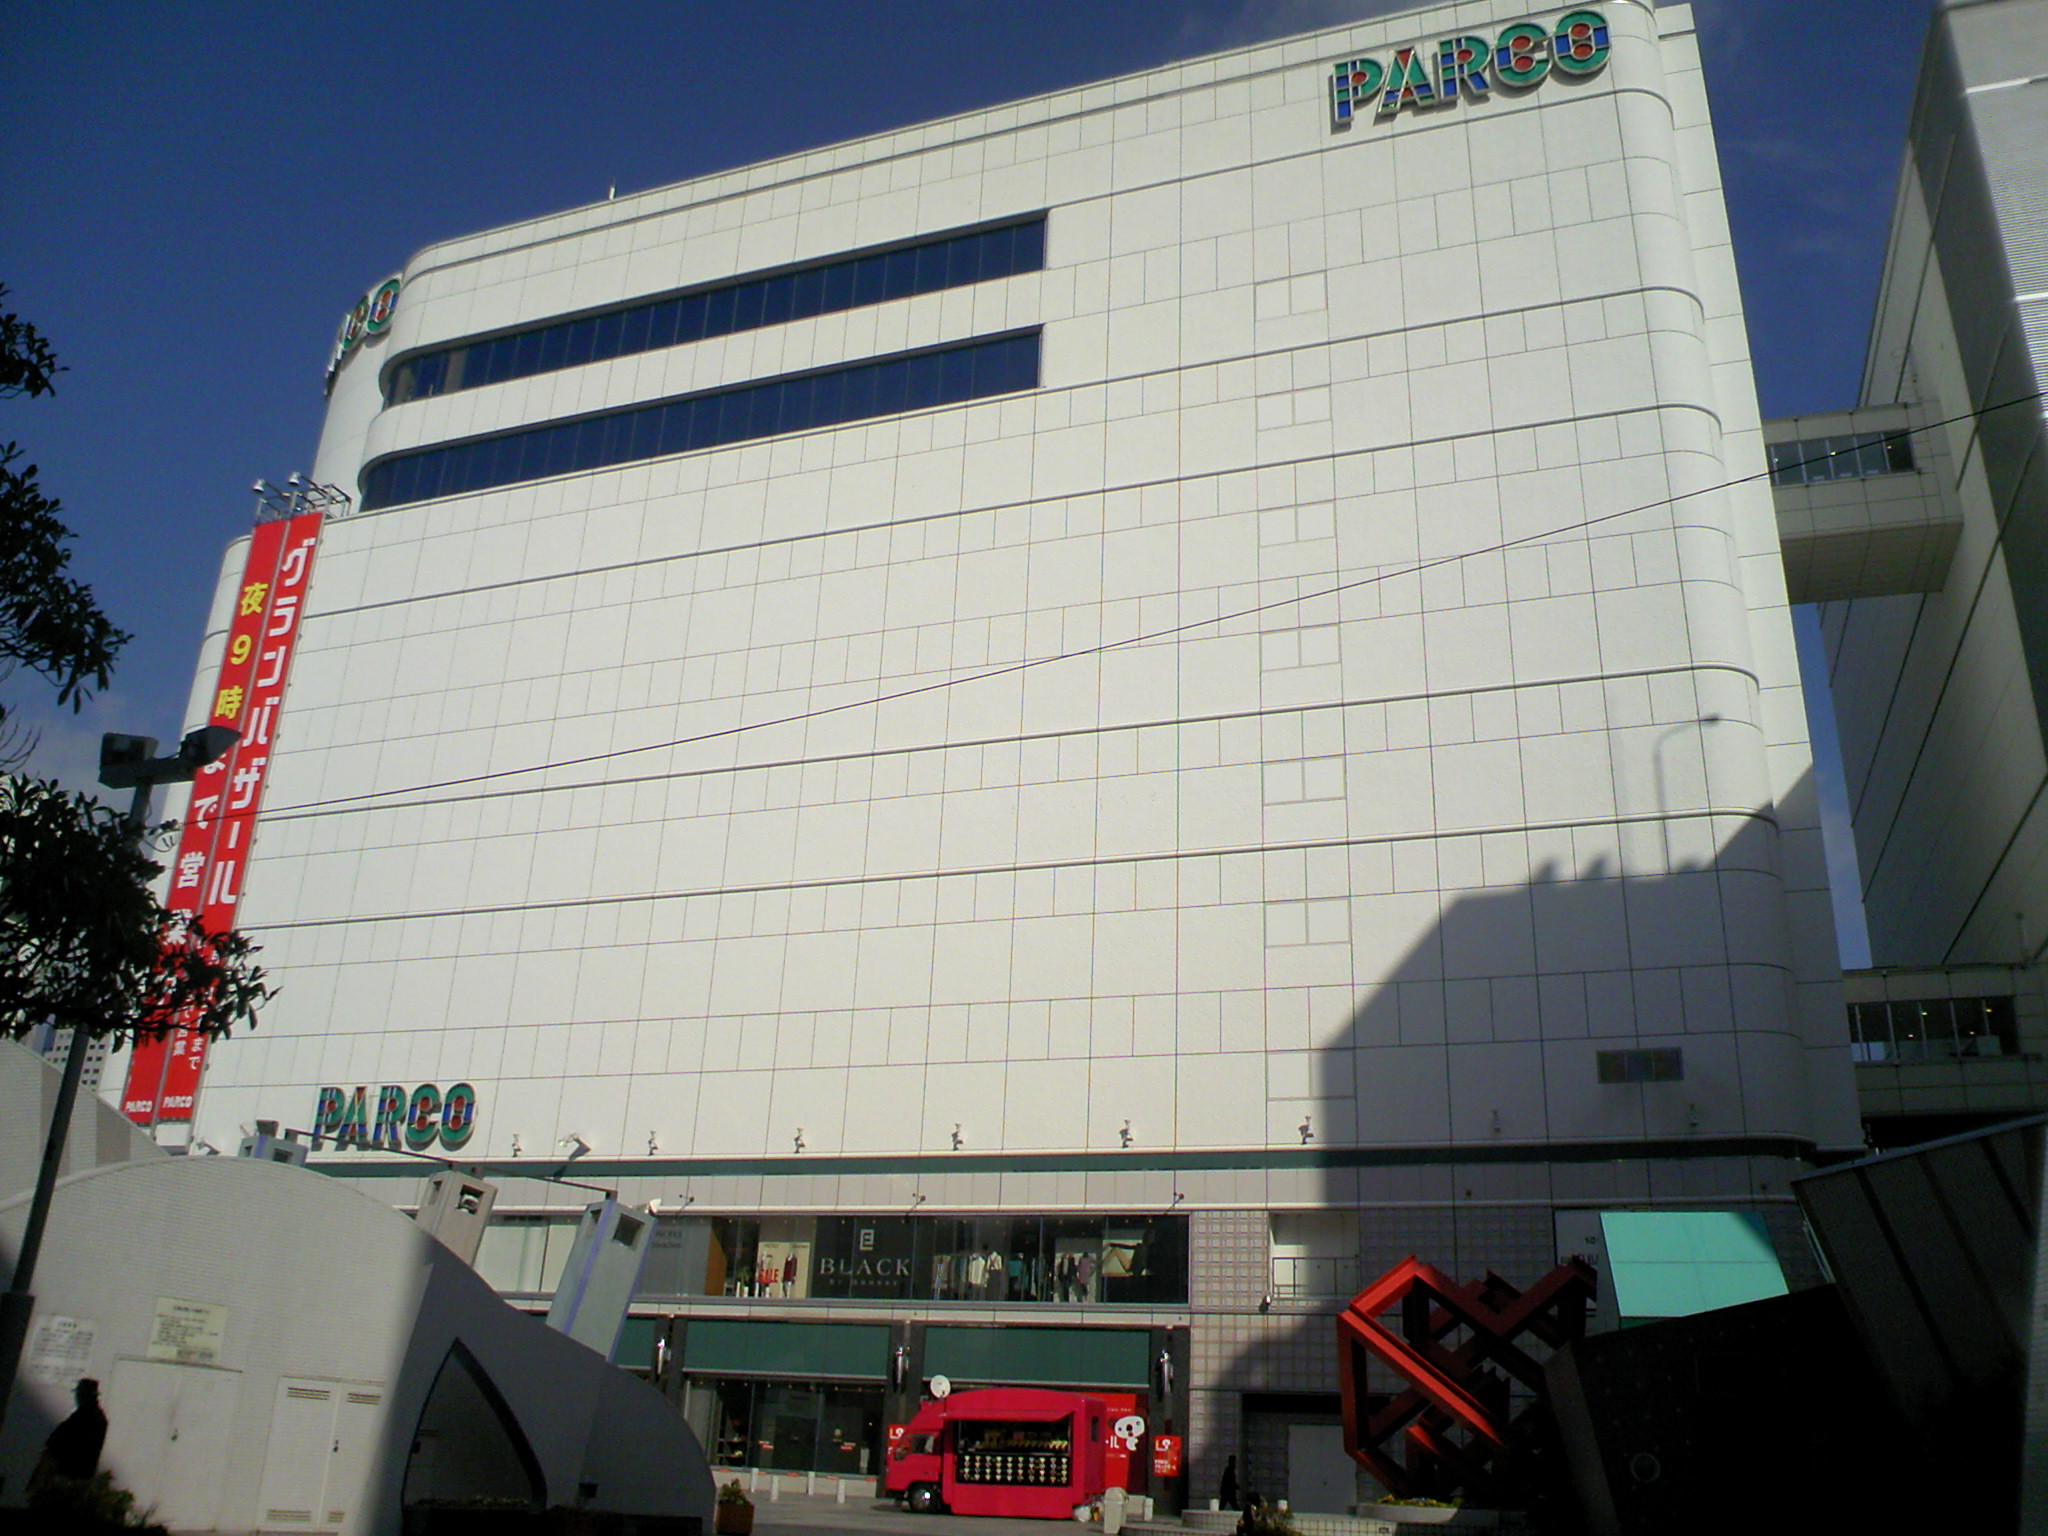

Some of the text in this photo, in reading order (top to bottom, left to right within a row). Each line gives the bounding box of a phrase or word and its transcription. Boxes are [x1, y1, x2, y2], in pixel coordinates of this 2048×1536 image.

[1332, 9, 1611, 123] PARCO
[208, 537, 316, 906] グランバザール
[124, 1100, 153, 1112] PARCO
[162, 1096, 193, 1108] PARCO
[311, 1082, 476, 1150] PARCO
[820, 1257, 910, 1276] BLACK
